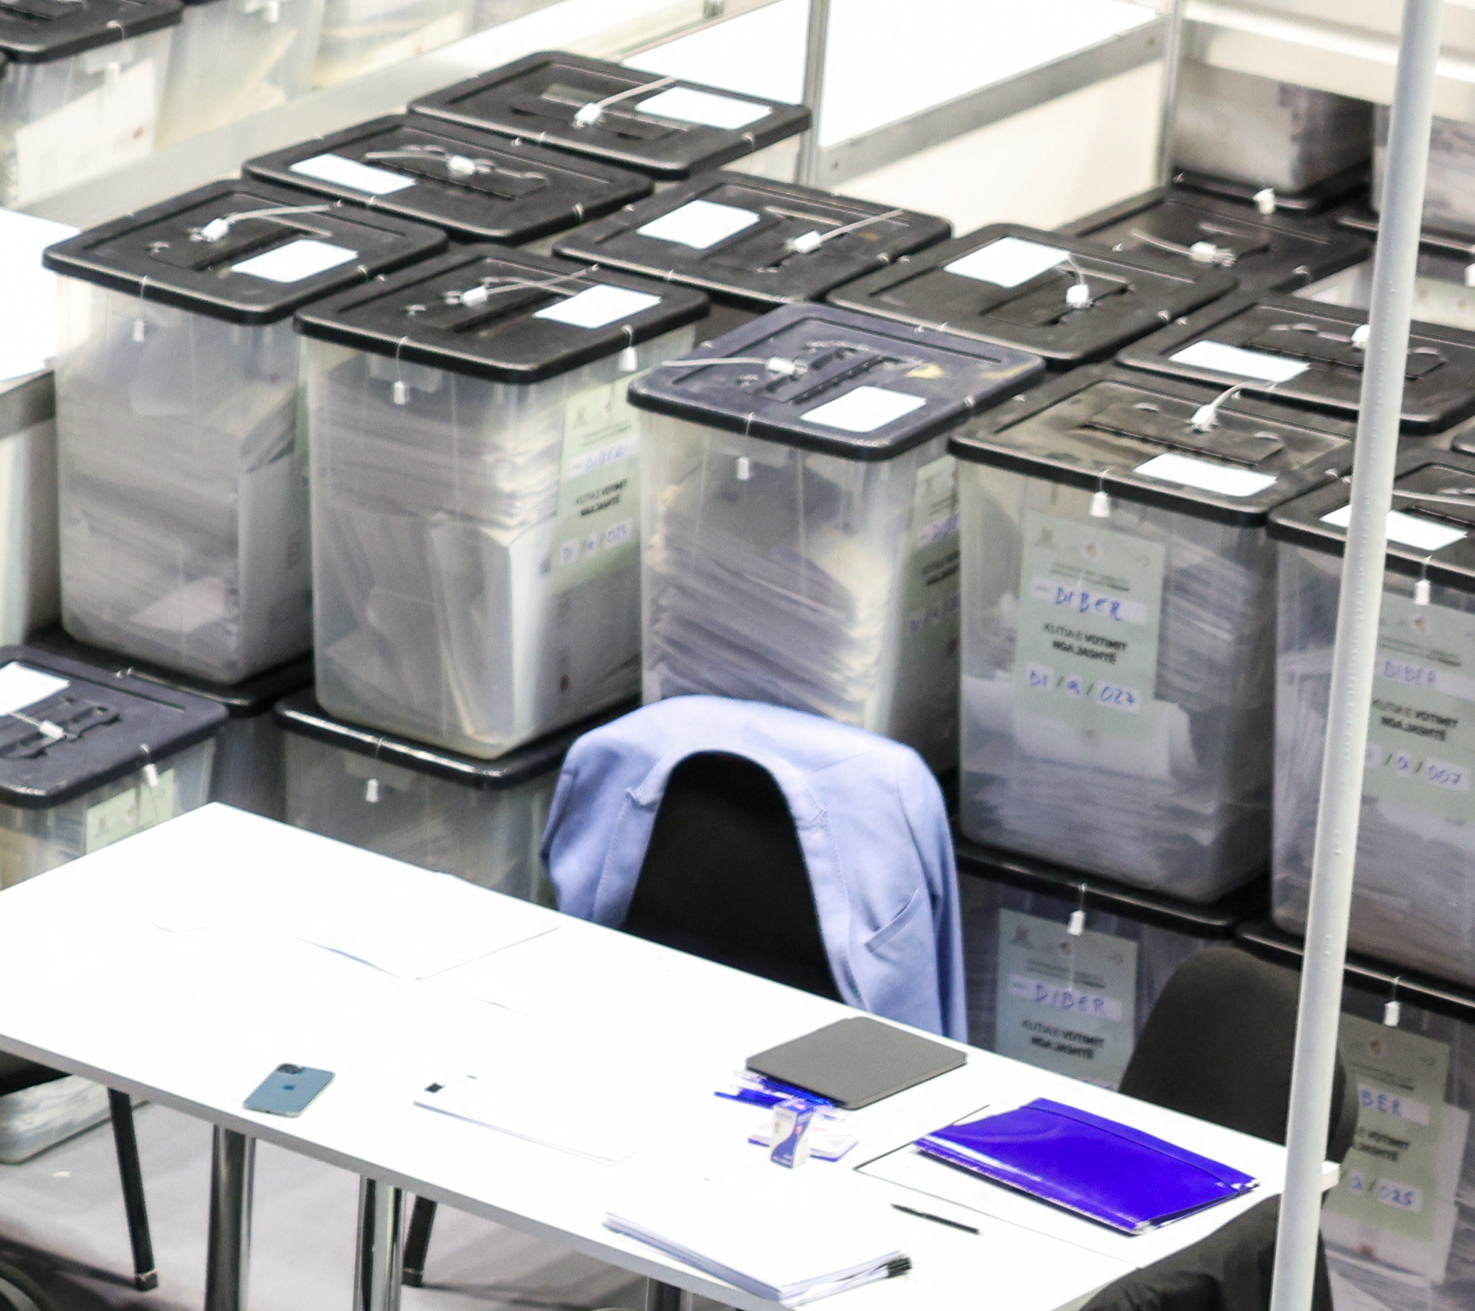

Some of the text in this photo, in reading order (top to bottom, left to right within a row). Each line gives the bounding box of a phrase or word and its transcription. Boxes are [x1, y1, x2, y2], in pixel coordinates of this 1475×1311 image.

[1054, 587, 1123, 622] DIBER
[1085, 634, 1128, 650] VOTIMIT
[1035, 982, 1107, 1017] DIBER
[1360, 1088, 1403, 1118] BER
